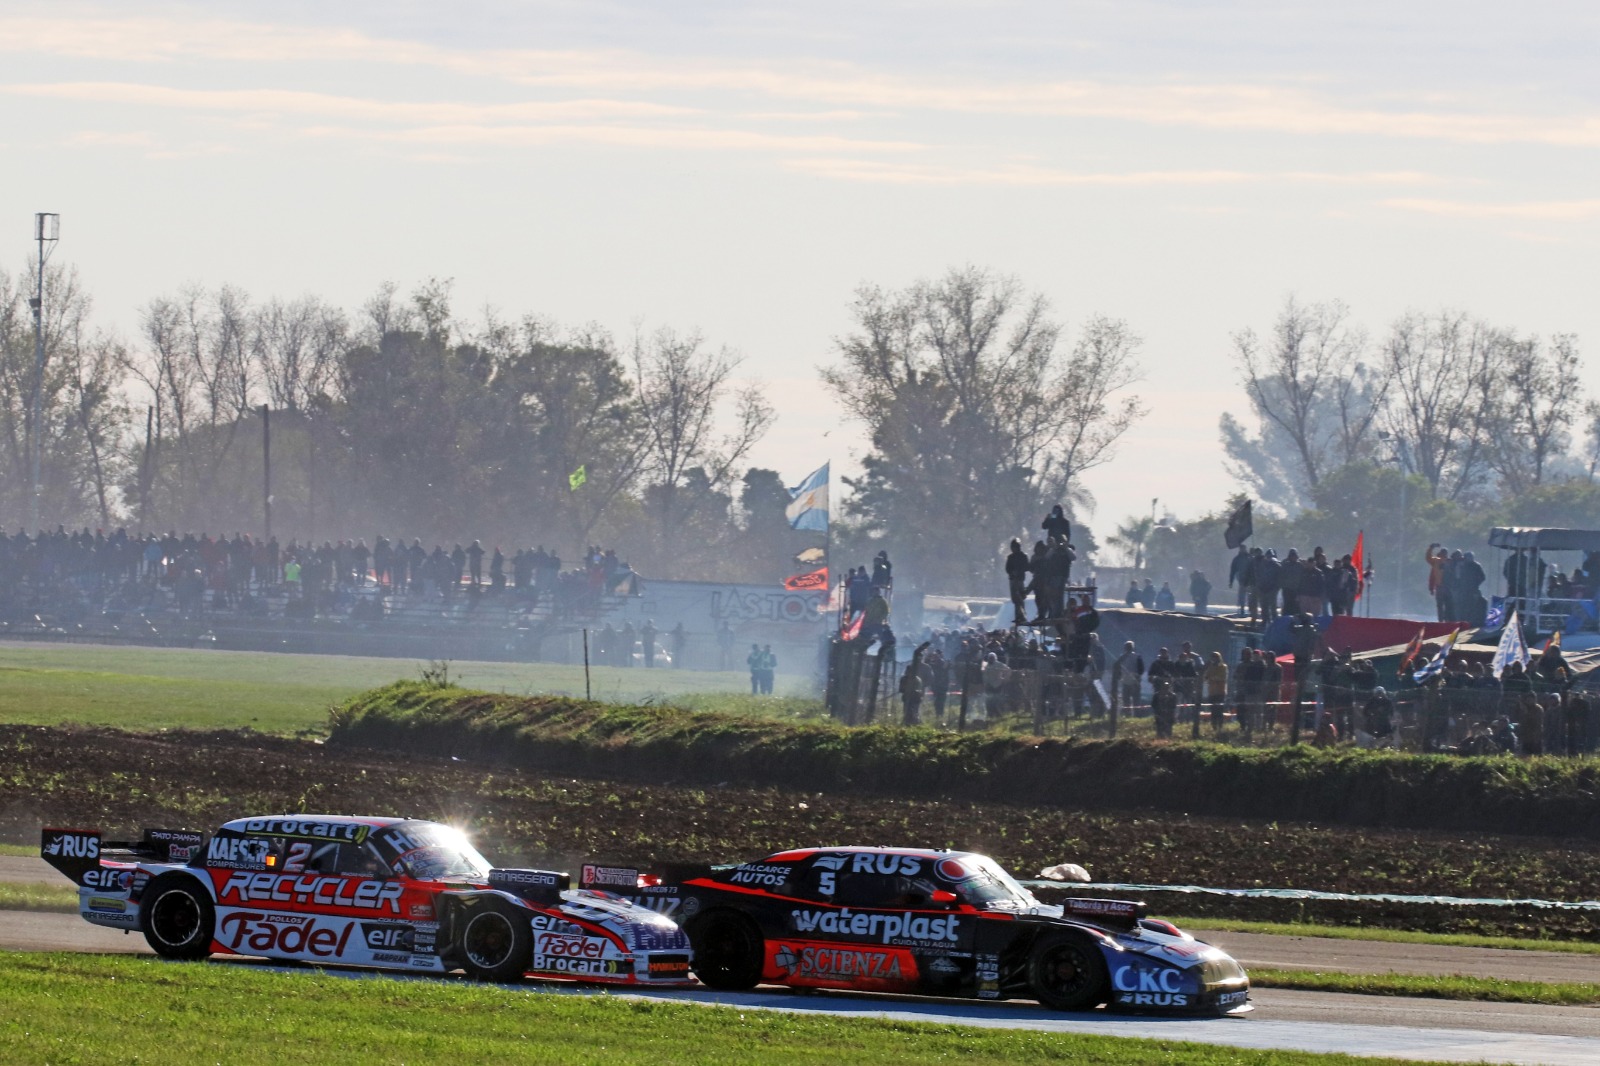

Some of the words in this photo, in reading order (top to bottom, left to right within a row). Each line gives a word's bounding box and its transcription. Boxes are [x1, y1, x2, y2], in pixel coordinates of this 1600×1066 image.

[247, 820, 358, 839] Brocart
[63, 835, 99, 859] RUS
[207, 837, 269, 863] KAESER
[283, 842, 312, 873] 2
[736, 863, 792, 875] BALCARCE
[852, 852, 922, 876] RUS
[83, 870, 120, 887] elf
[490, 872, 555, 885] MANASSERO
[730, 872, 786, 886] AUTOS
[818, 872, 836, 895] 5
[269, 915, 303, 924] POLLOS
[791, 907, 960, 944] waterplast
[221, 911, 355, 957] Fadel
[368, 929, 403, 947] elf
[892, 938, 917, 947] CUIDA
[919, 940, 931, 948] TU
[932, 941, 957, 949] AGUA
[538, 932, 607, 959] Fadel
[534, 954, 607, 974] Brocart
[801, 947, 902, 979] SCIENZA
[1115, 965, 1181, 993] CKC
[1133, 993, 1188, 1006] RUS
